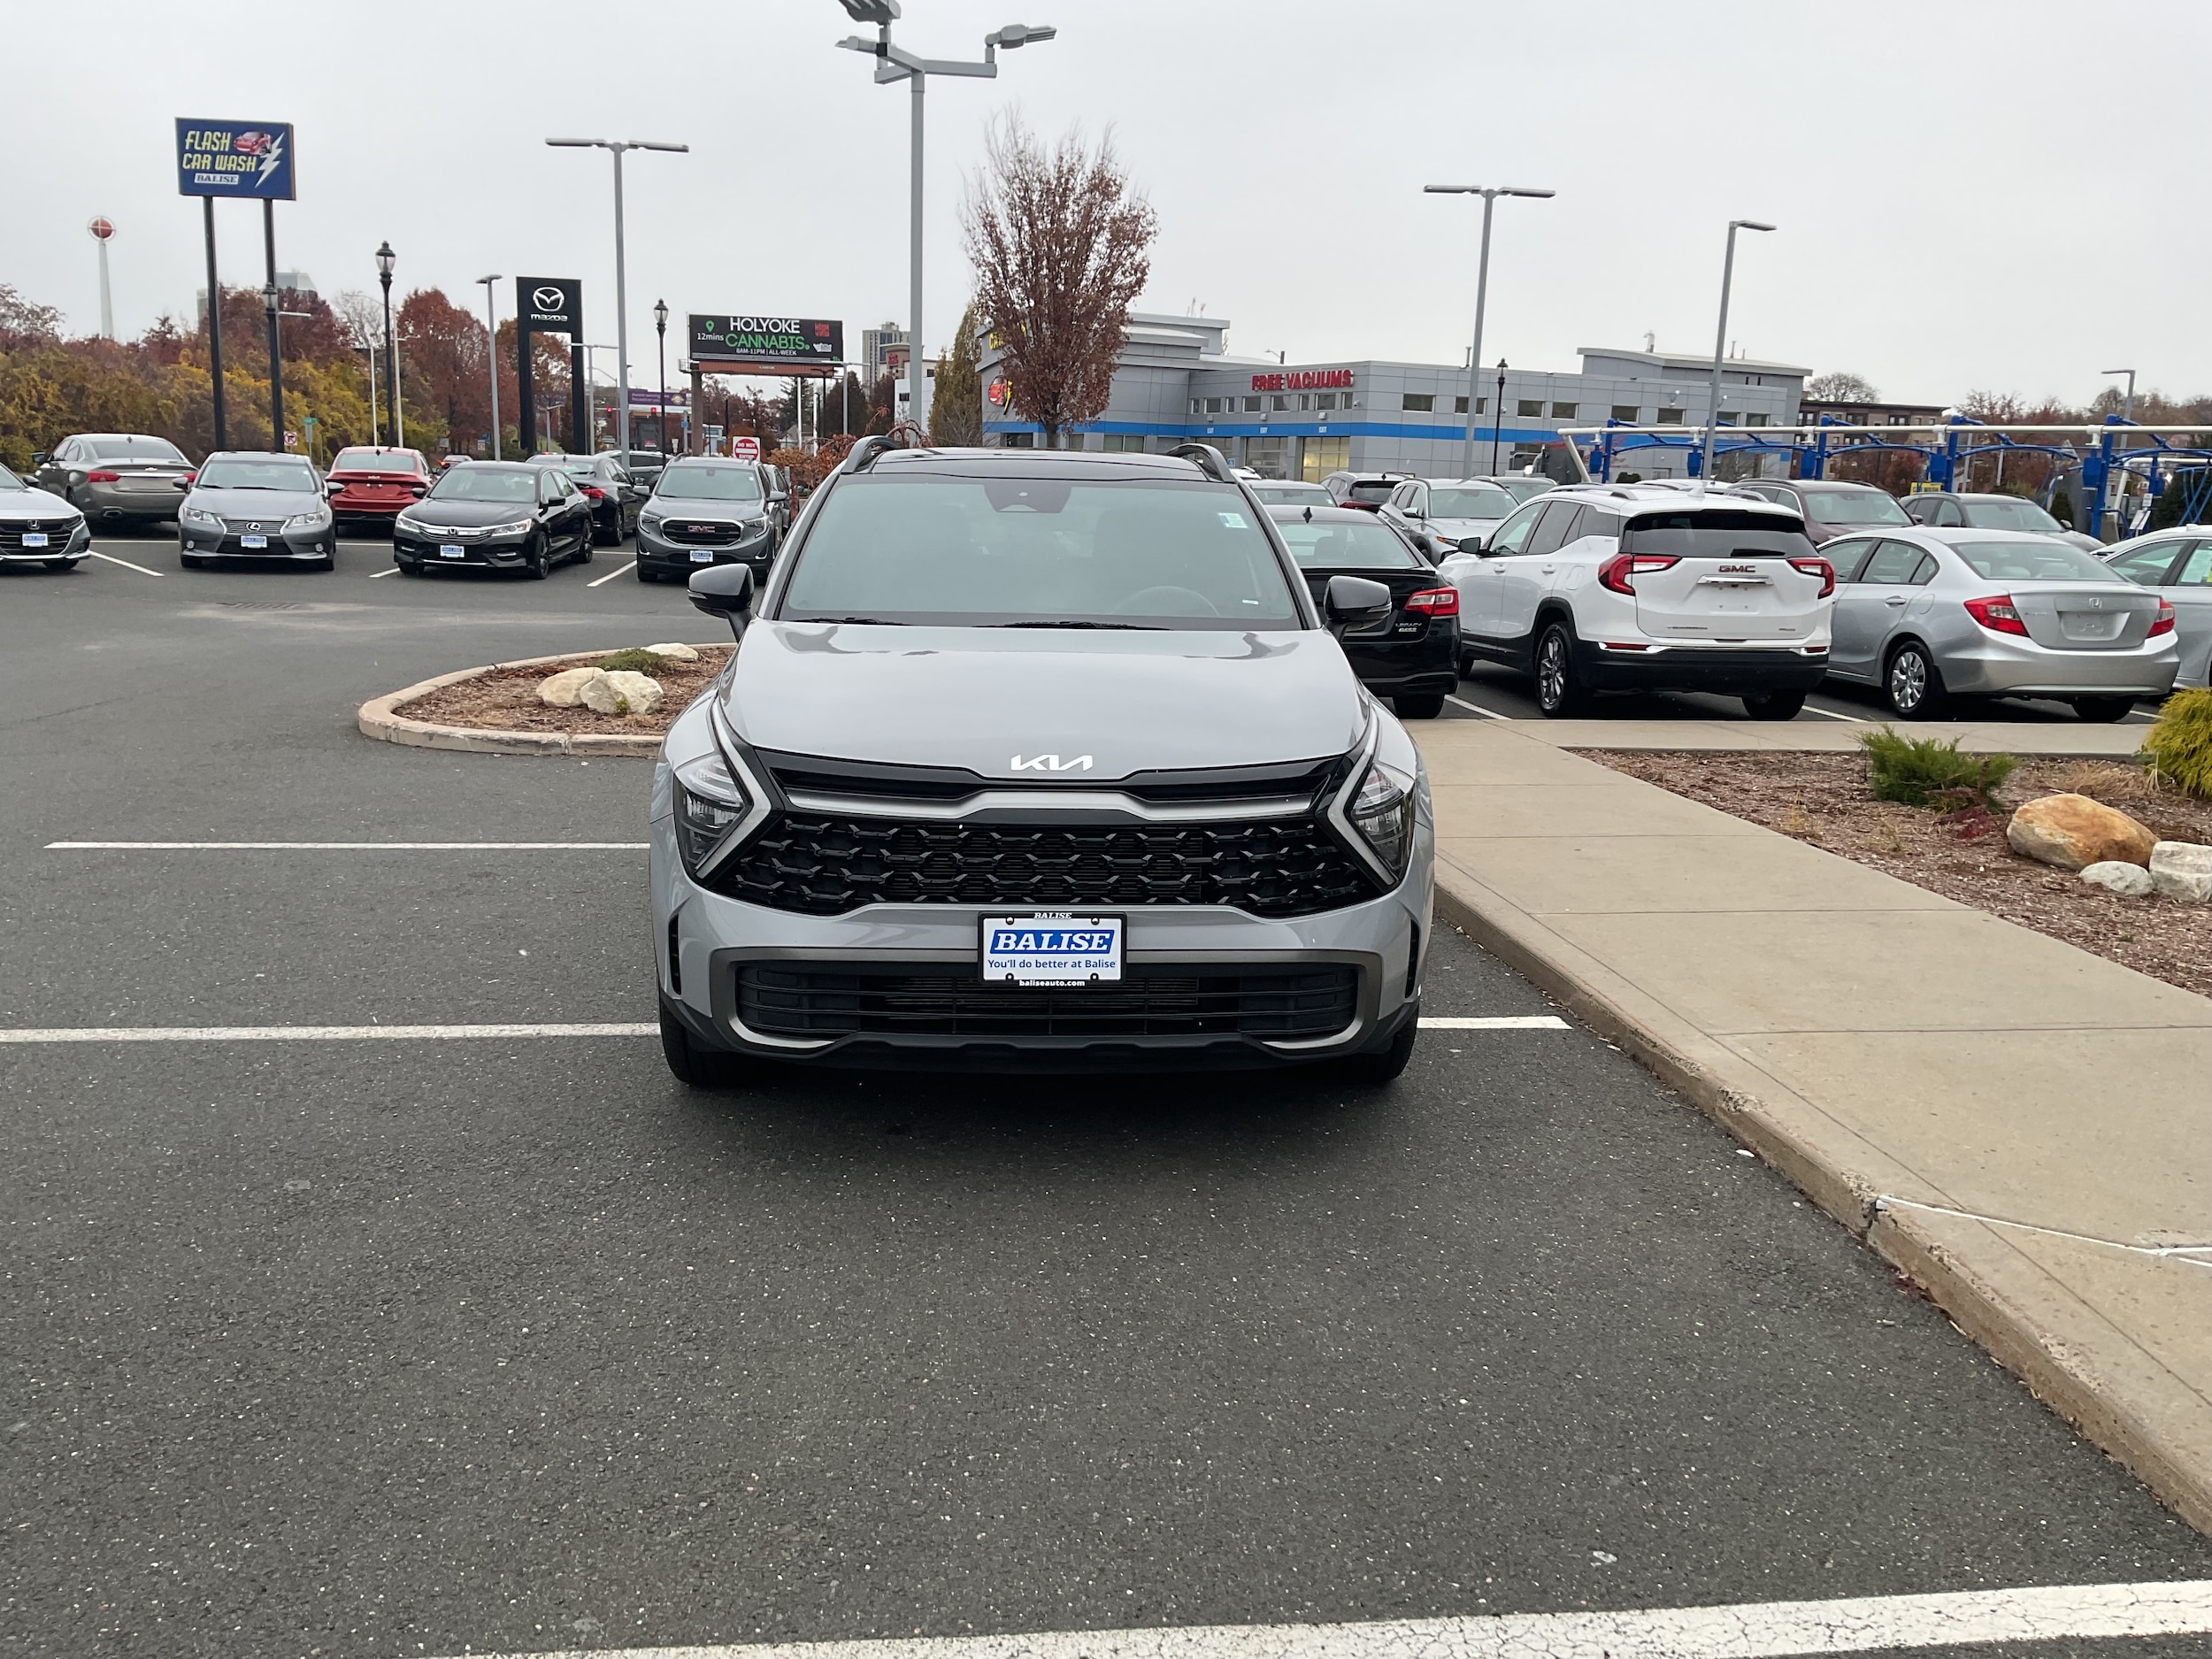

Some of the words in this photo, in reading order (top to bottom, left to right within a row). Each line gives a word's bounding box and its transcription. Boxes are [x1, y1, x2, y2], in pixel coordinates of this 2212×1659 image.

[185, 131, 231, 151] FLASH
[182, 153, 211, 170] CAR
[214, 155, 257, 172] WASH
[730, 317, 801, 334] HOLYOKE
[697, 332, 724, 342] 12mins
[1251, 374, 1284, 391] FREE
[1286, 369, 1353, 389] VACUUMS
[1010, 754, 1094, 772] KIA
[995, 933, 1111, 951] BALISE
[987, 959, 1016, 968] You'll
[1019, 959, 1032, 968] do
[1035, 959, 1068, 968] better
[1085, 959, 1116, 968] Balise
